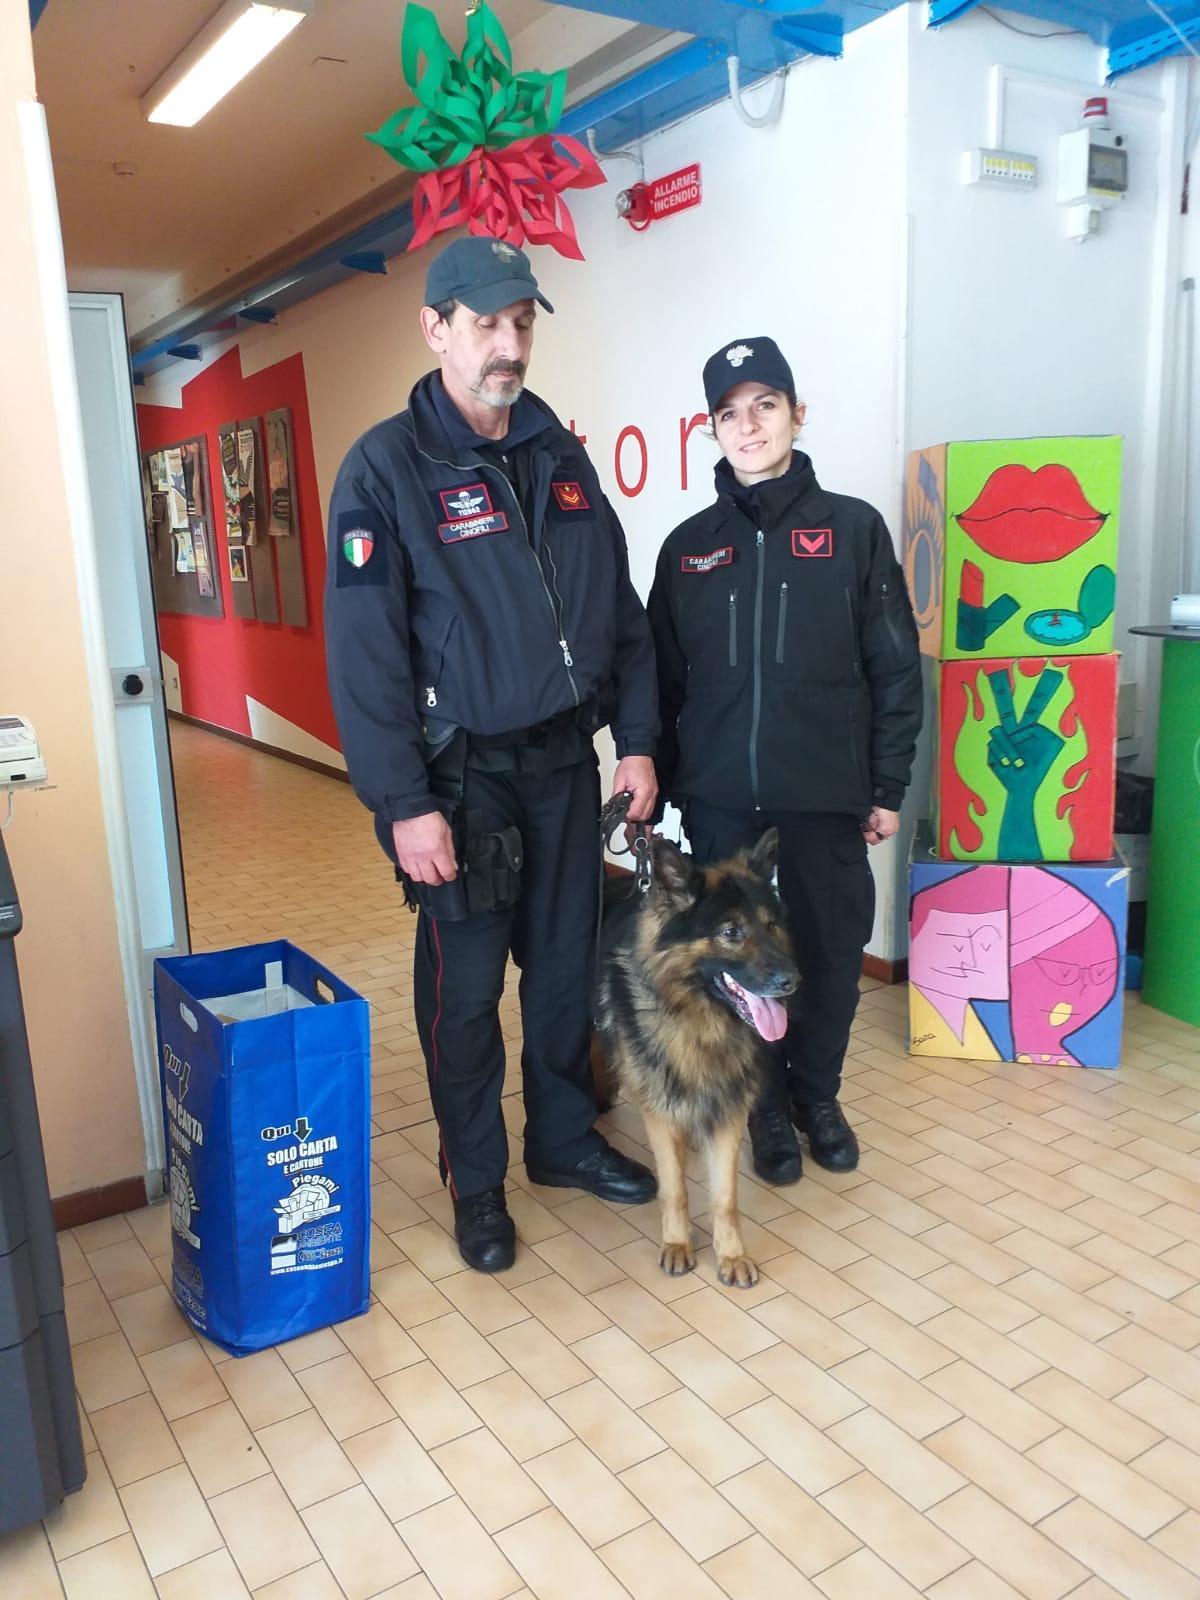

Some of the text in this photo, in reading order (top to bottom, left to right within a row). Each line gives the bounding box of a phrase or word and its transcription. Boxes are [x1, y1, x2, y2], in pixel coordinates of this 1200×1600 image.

[654, 171, 697, 199] ALLARME
[653, 186, 698, 213] INCENDIO
[177, 1103, 203, 1147] CARTA
[261, 1125, 291, 1141] Qui
[267, 1136, 337, 1167] SOLO CARTA
[283, 1156, 323, 1174] E CARTONE
[292, 1174, 340, 1194] Piegami
